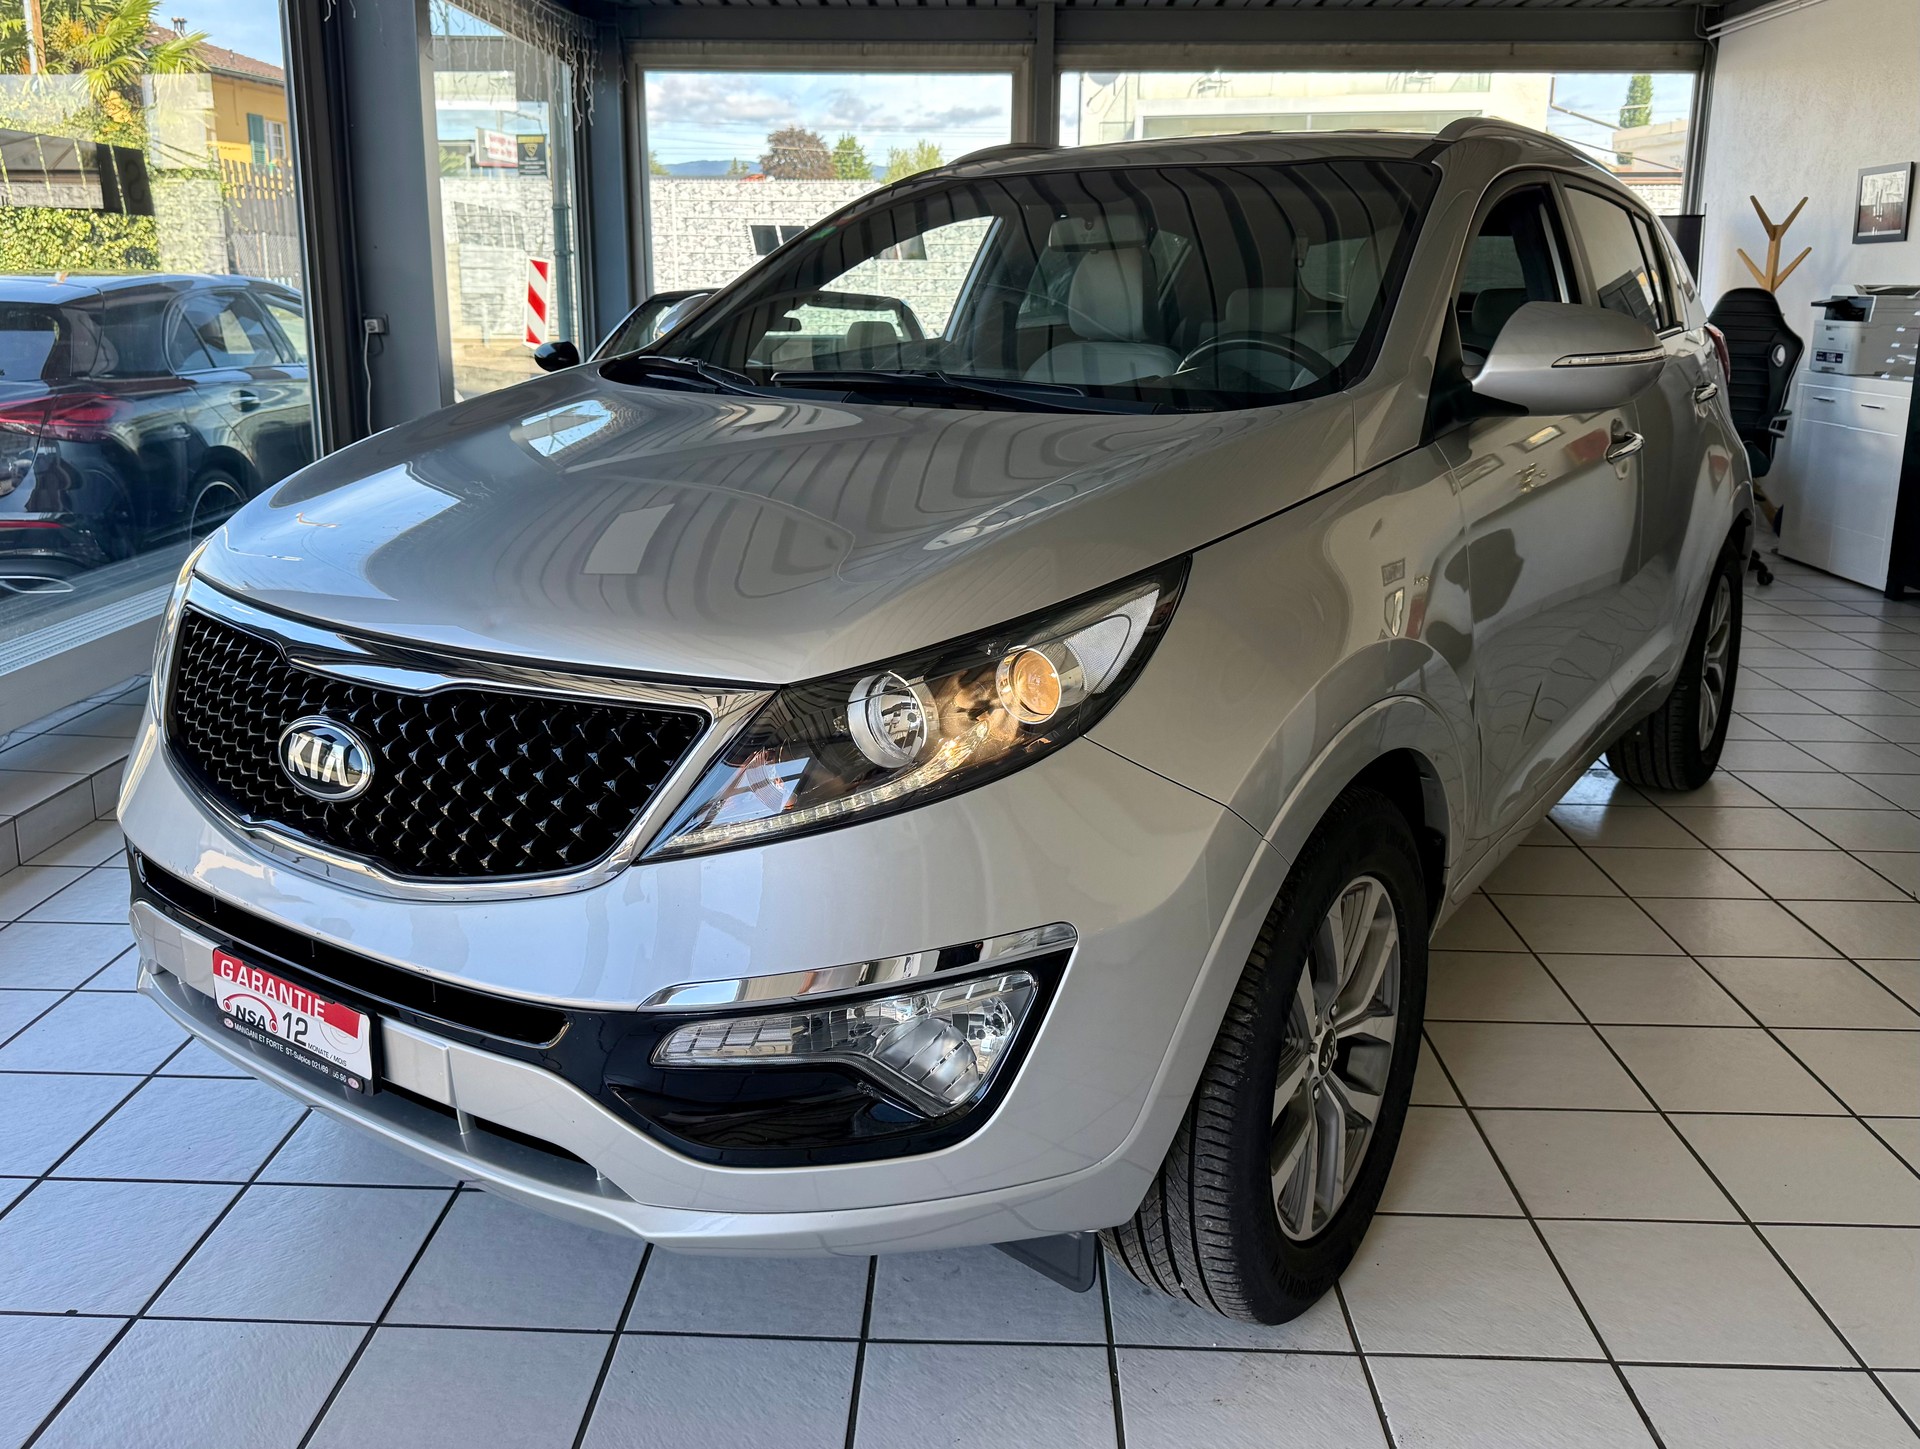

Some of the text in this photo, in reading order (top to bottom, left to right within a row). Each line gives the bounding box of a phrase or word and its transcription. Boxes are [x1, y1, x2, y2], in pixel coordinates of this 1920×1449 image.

[288, 733, 349, 787] KIA
[220, 959, 327, 1021] GARANTIE
[235, 1004, 267, 1031] NSA
[282, 1011, 309, 1047] 12
[258, 1033, 266, 1043] ET
[265, 1037, 284, 1053] FORTE
[308, 1042, 330, 1059] MONATE
[333, 1055, 348, 1067] MOIS
